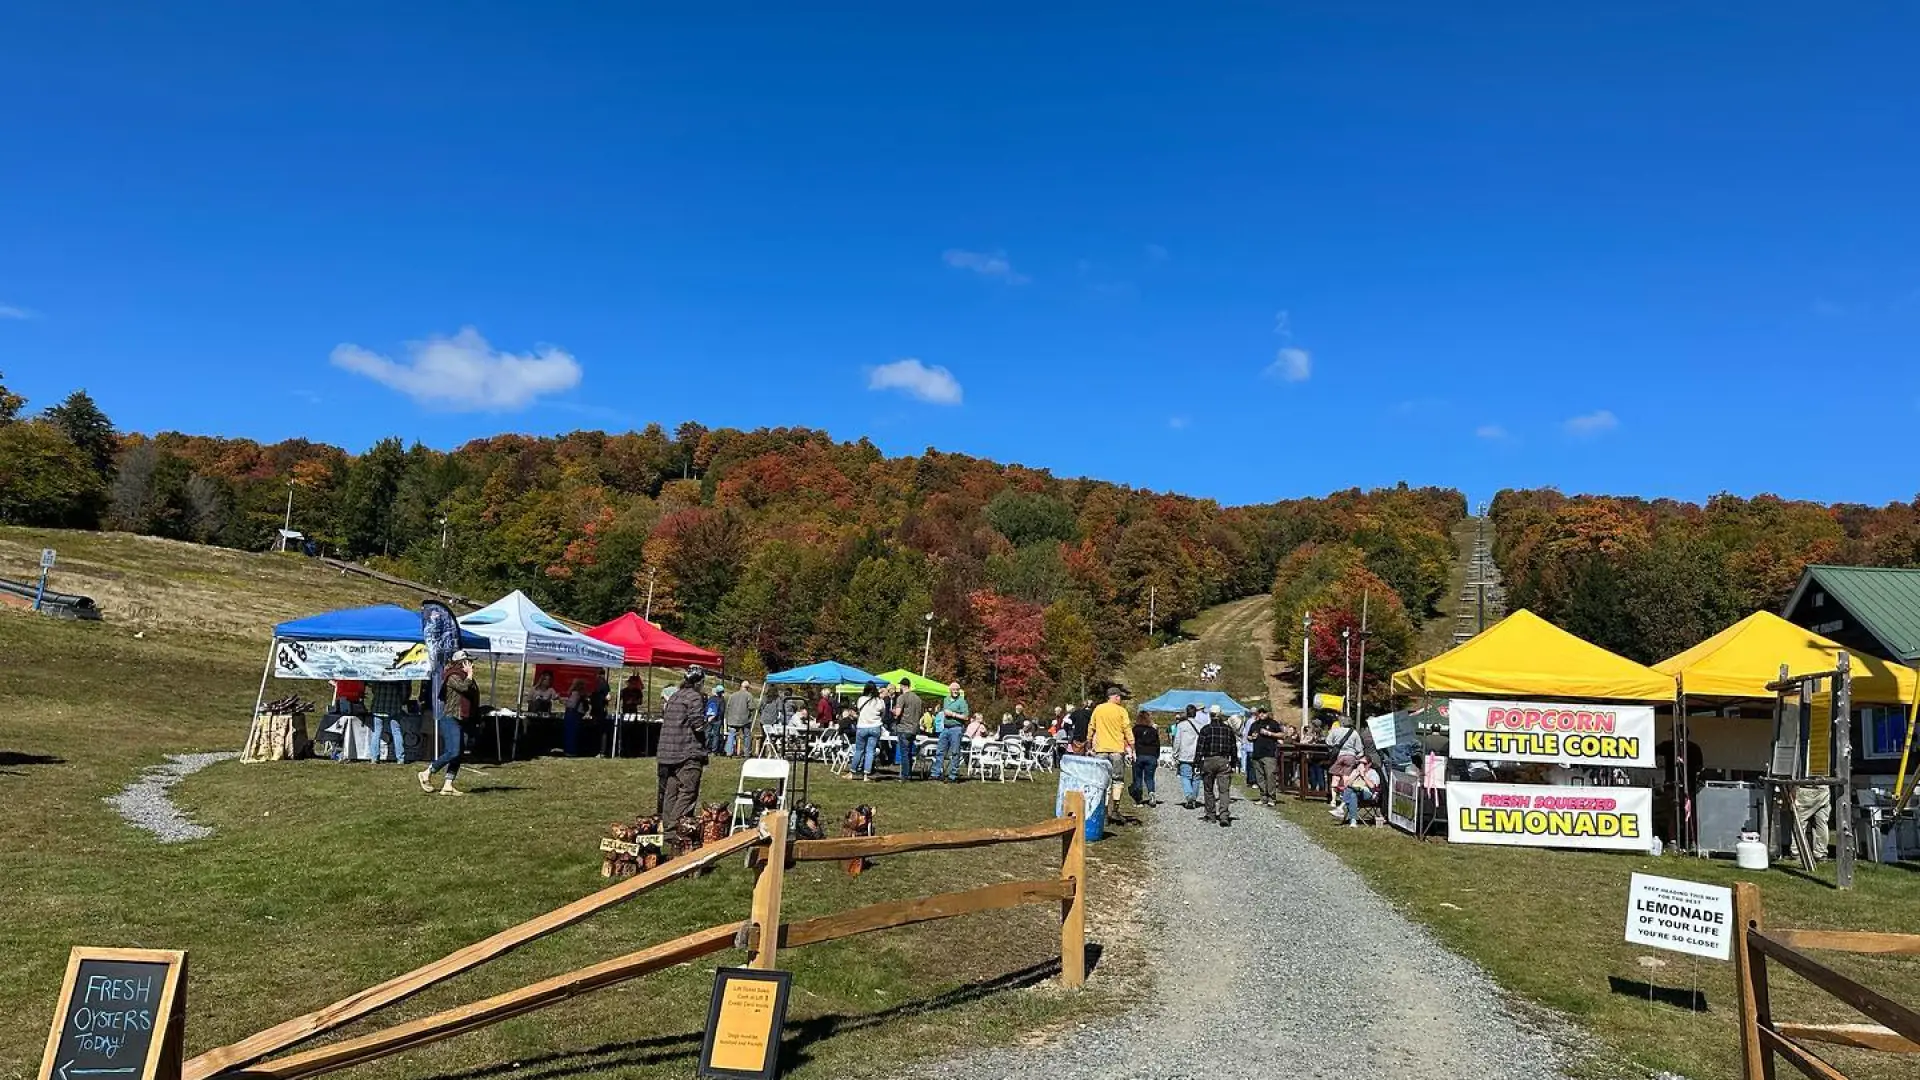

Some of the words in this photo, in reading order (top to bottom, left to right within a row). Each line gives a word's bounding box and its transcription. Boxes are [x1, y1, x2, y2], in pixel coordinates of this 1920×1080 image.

[306, 643, 328, 652] Make
[349, 645, 366, 653] own
[536, 639, 561, 649] North
[562, 641, 581, 653] Creek
[1486, 707, 1616, 734] POPCORN
[1465, 731, 1559, 756] KETTLE
[1563, 735, 1639, 758] CORN
[1480, 794, 1532, 809] FRESH
[1533, 795, 1616, 811] SQUEEZED
[1460, 808, 1639, 838] LEMONADE
[1661, 888, 1688, 897] HEADING
[1690, 892, 1704, 900] THIS
[1637, 899, 1724, 925] LEMONADE
[1640, 915, 1653, 925] OF
[1658, 918, 1689, 931] YOUR
[1694, 924, 1719, 937] LIFE
[1638, 928, 1669, 940] YOU'RE
[1686, 938, 1719, 949] CLOSE!
[84, 975, 151, 1003] FRESH
[74, 1007, 151, 1031] OYSTERS
